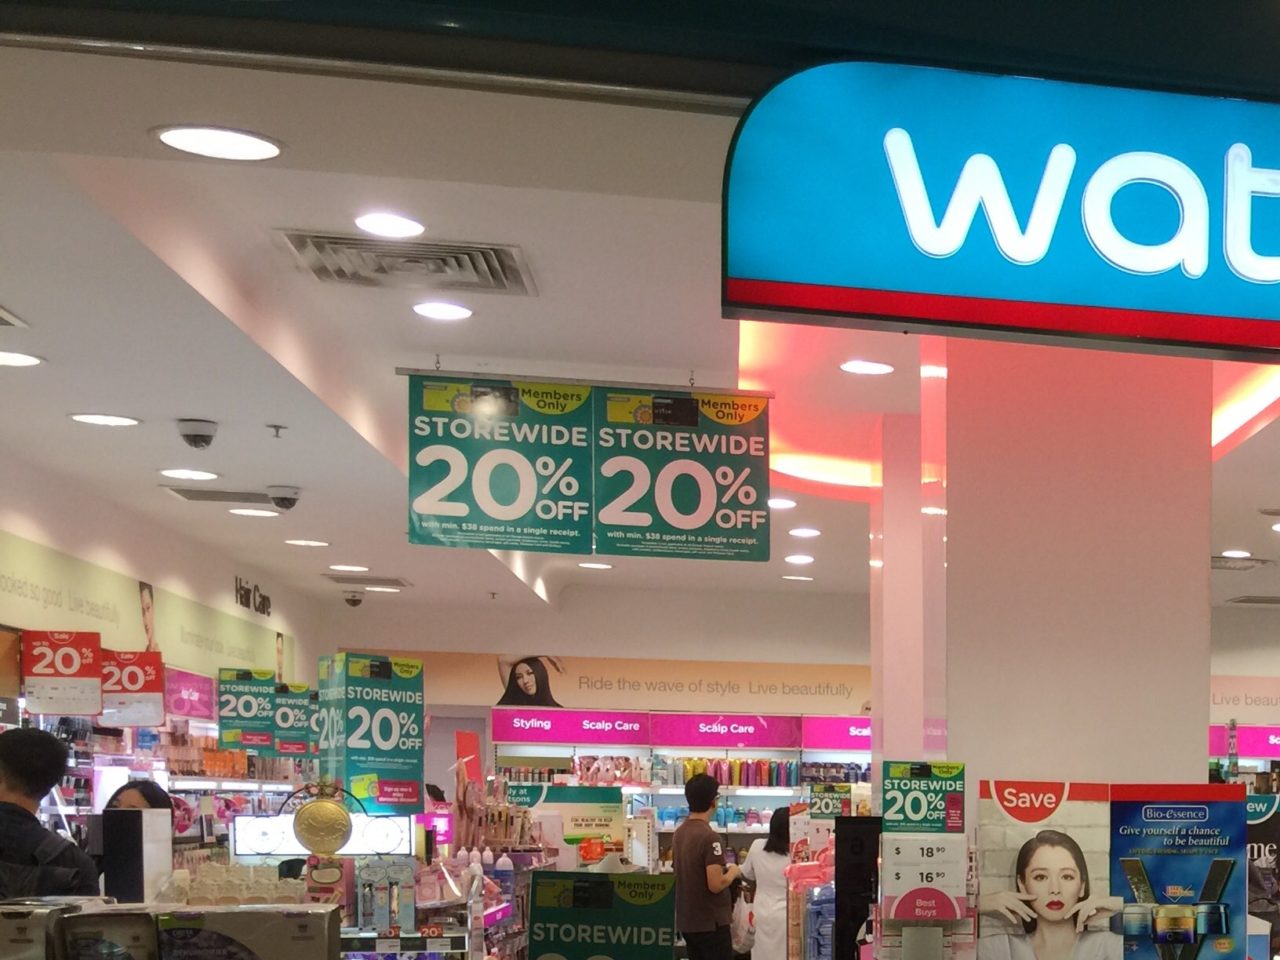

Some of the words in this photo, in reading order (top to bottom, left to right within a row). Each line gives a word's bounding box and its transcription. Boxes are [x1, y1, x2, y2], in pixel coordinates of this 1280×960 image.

[521, 388, 583, 403] Members
[536, 398, 568, 412] Only
[700, 399, 760, 413] Members
[715, 409, 745, 423] Only
[414, 416, 588, 447] STOREWIDE
[598, 427, 765, 456] STOREWIDE
[412, 444, 580, 521] 20%
[598, 456, 758, 530] 20%
[536, 499, 590, 522] OFF
[715, 509, 767, 530] OFF
[607, 531, 627, 539] with
[629, 532, 645, 540] min.
[646, 533, 660, 541] $38
[662, 534, 687, 543] spend
[704, 535, 728, 545] single
[729, 536, 760, 545] receipt.
[235, 576, 251, 610] Hair
[253, 584, 272, 617] Care
[220, 684, 275, 694] STOREWIDE
[579, 676, 613, 691] Ride
[617, 678, 641, 692] the
[645, 682, 684, 693] wave
[688, 679, 705, 693] of
[707, 680, 740, 696] style
[749, 681, 778, 694] Live
[781, 682, 854, 699] beautifully
[347, 686, 423, 704] STOREWIDE
[1212, 693, 1240, 706] Live
[347, 705, 419, 751] 20%
[513, 717, 551, 730] Styling
[582, 719, 612, 731] Scalp
[615, 720, 640, 731] Care
[699, 722, 728, 735] Scalp
[730, 723, 755, 734] Care
[849, 725, 871, 737] Scal
[400, 738, 422, 750] OFF
[883, 779, 964, 792] STOREWIDE
[1003, 788, 1057, 808] Save
[883, 790, 945, 821] 20%
[1247, 802, 1268, 812] ew
[926, 811, 946, 820] OFF
[1146, 808, 1205, 820] Bio-essence
[1119, 826, 1141, 835] Give
[1142, 825, 1179, 837] yourself
[1188, 826, 1221, 835] chance
[1163, 837, 1173, 846] to
[1175, 837, 1187, 846] be
[1188, 836, 1230, 846] beautiful
[712, 842, 722, 856] 3
[894, 847, 901, 856] $
[919, 847, 935, 858] 18
[894, 872, 901, 881] $
[918, 872, 934, 883] 16
[617, 880, 666, 892] Members
[629, 889, 654, 900] Only
[916, 899, 937, 908] Best
[915, 907, 937, 917] Buys
[532, 922, 673, 946] STOREWIDE
